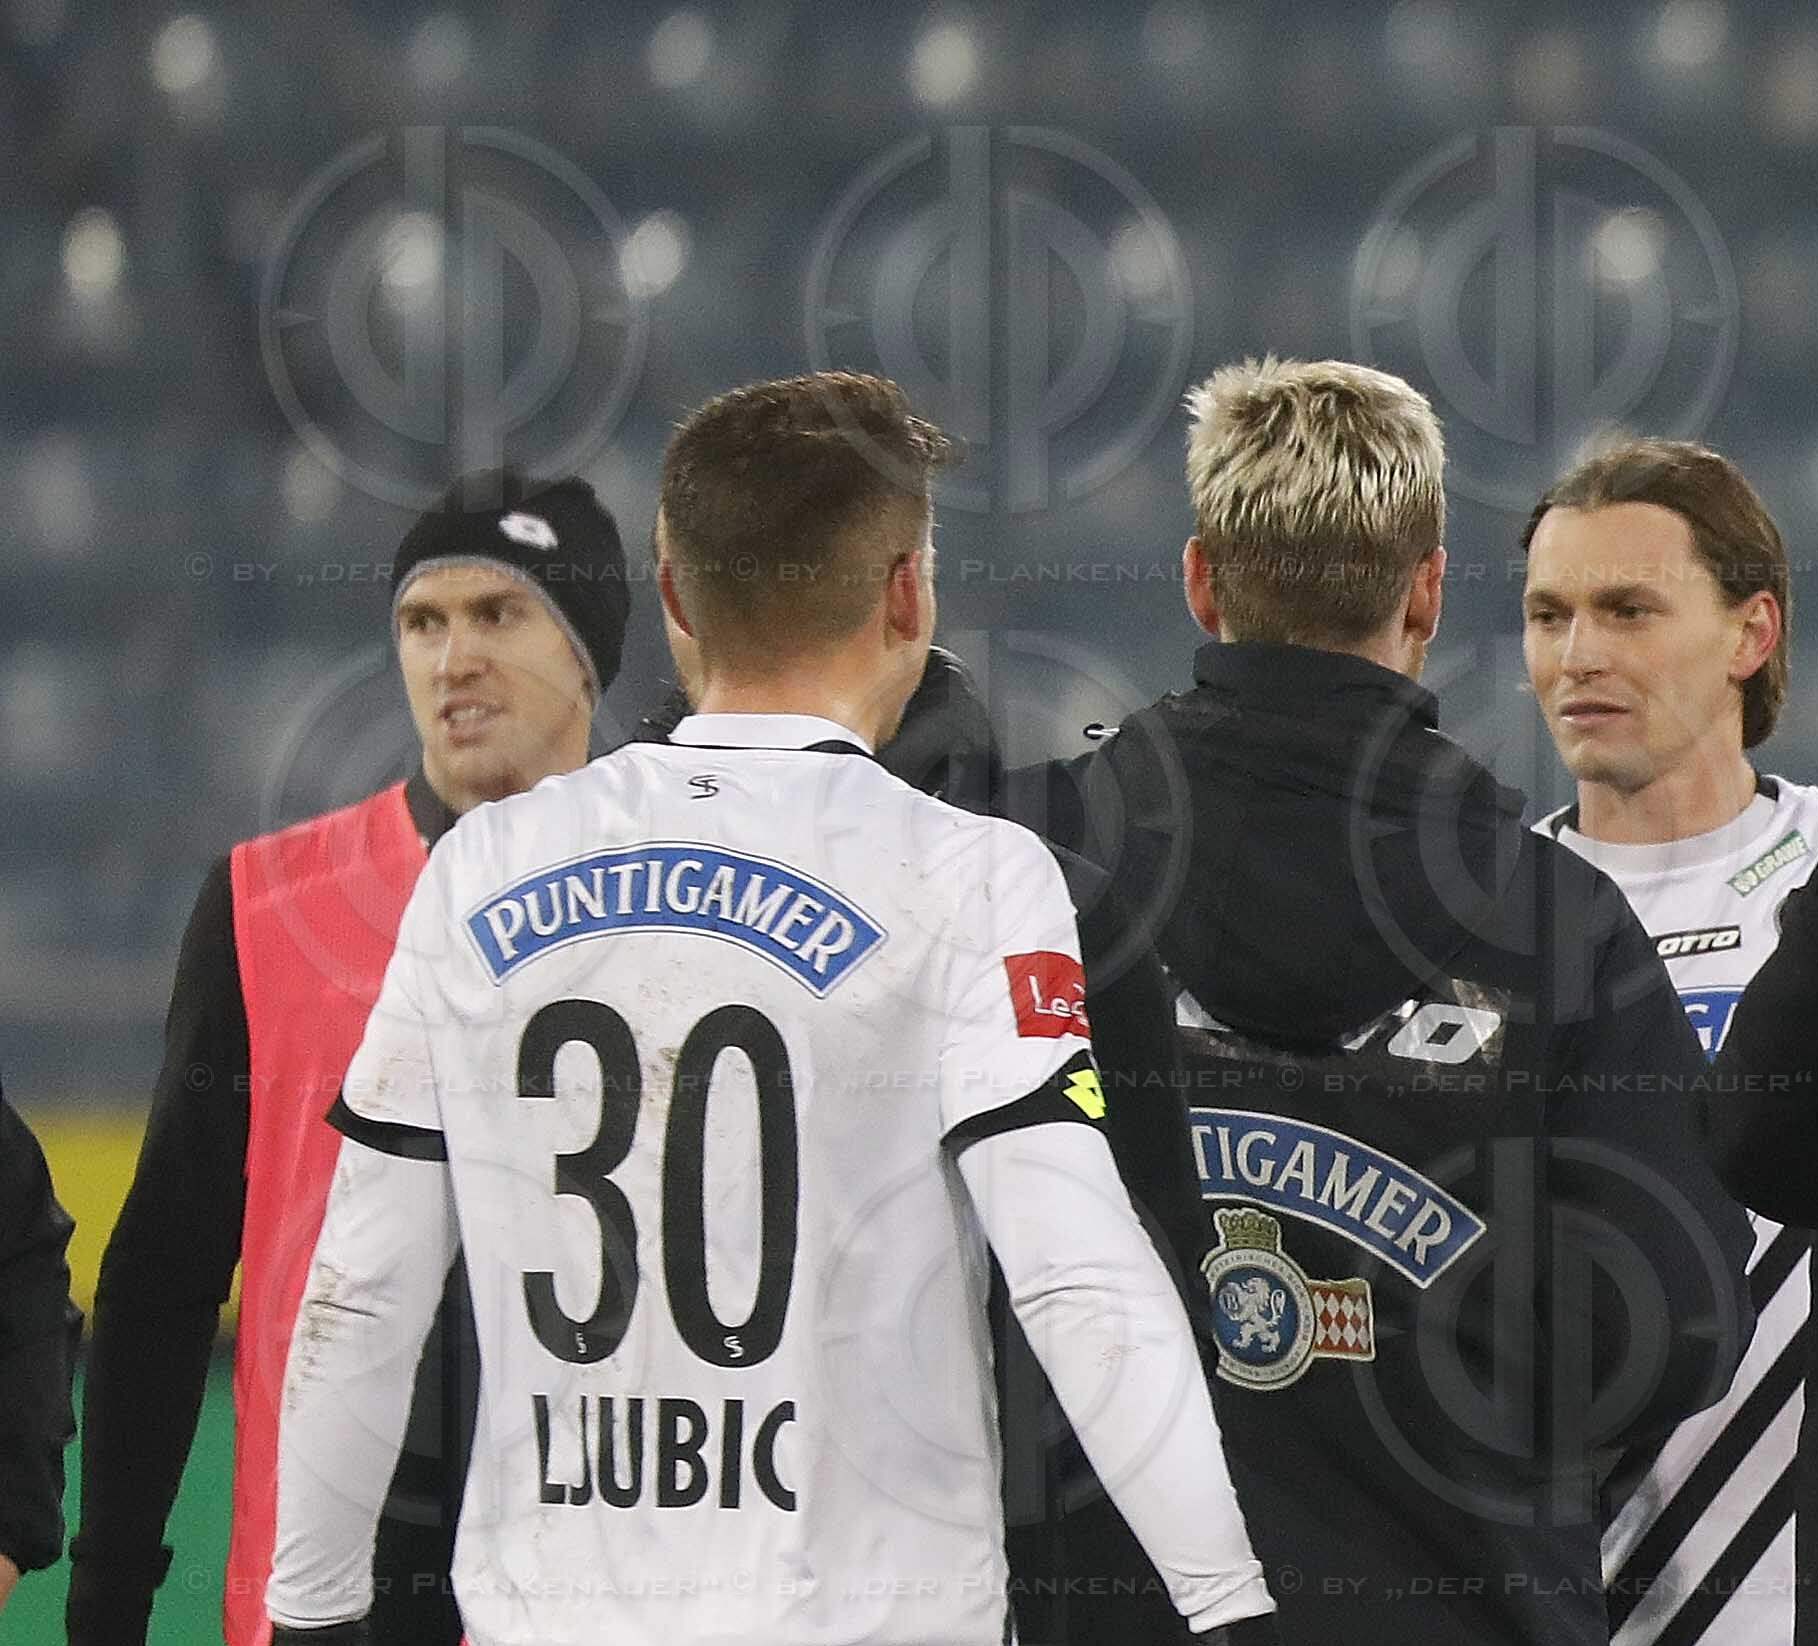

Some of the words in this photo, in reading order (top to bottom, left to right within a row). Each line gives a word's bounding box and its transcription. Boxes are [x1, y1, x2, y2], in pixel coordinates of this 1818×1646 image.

[482, 858, 858, 975] PUNTIGAMER
[1656, 929, 1741, 956] OTTO
[516, 998, 799, 1368] 30
[1191, 1123, 1453, 1266] TIGAMER
[531, 1394, 797, 1512] LJUBIC
